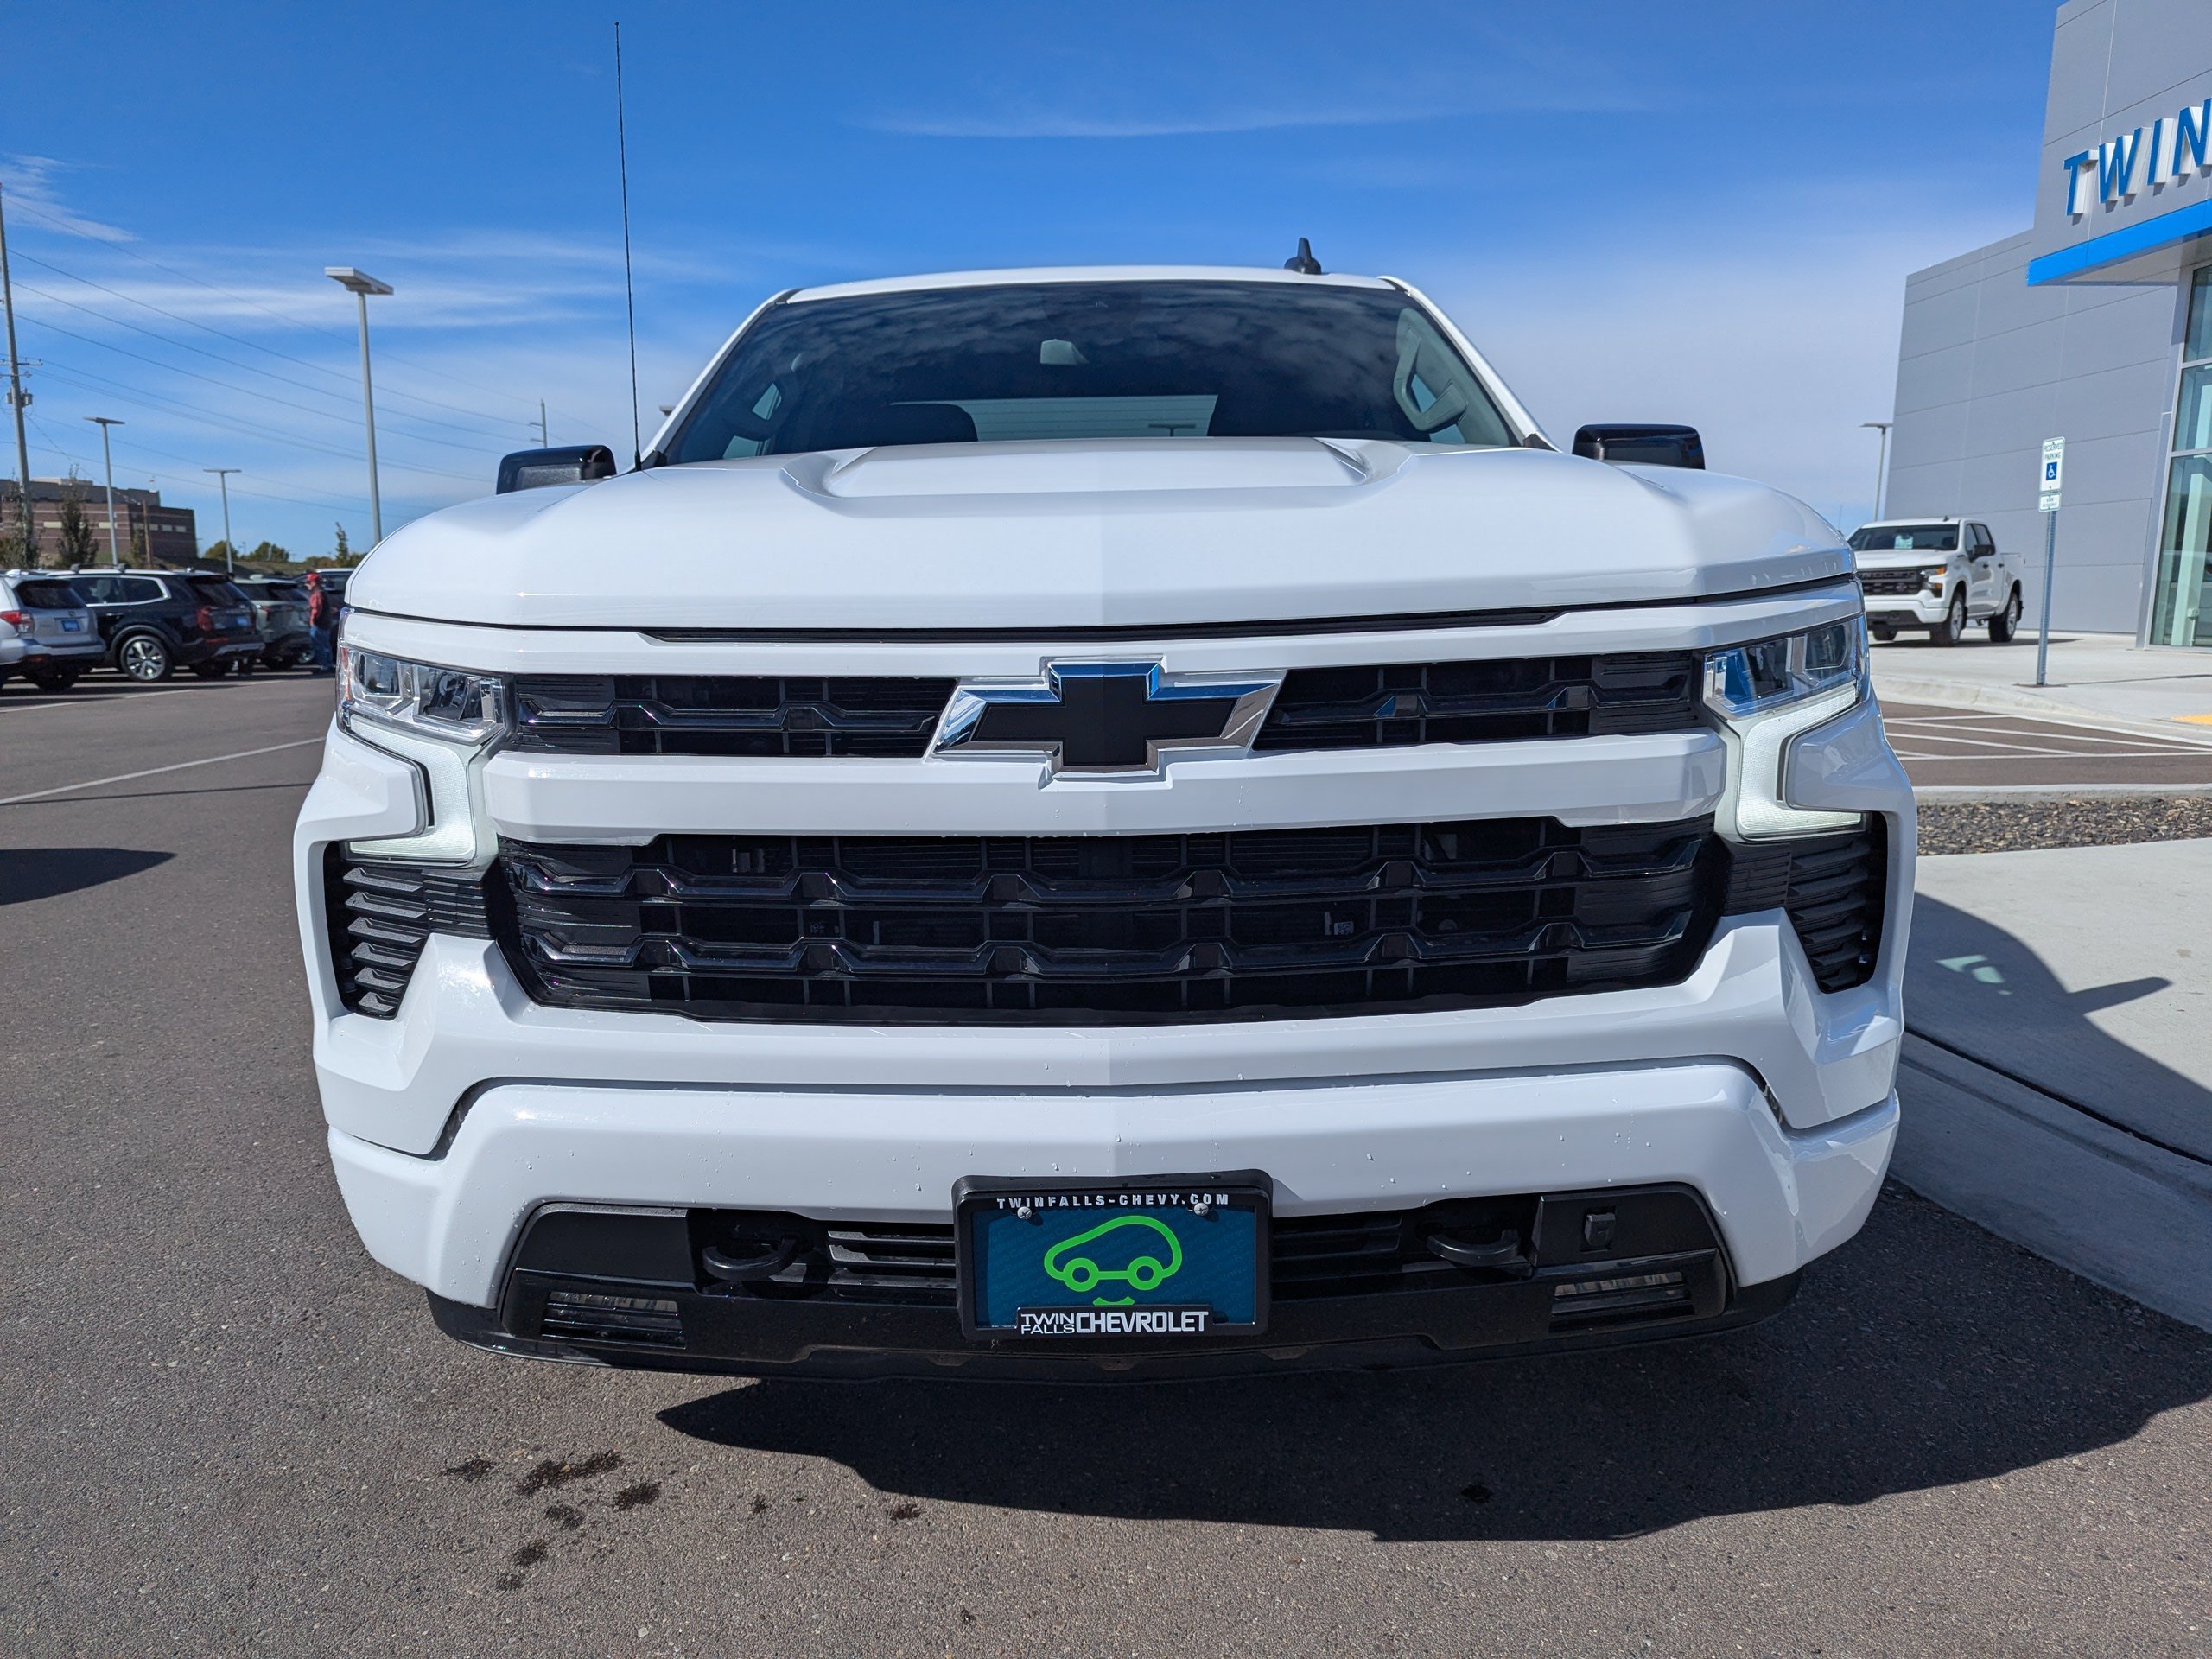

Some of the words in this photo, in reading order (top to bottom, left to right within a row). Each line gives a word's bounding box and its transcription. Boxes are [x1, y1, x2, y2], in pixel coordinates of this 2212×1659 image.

[2063, 98, 2212, 216] TWIN
[997, 1194, 1229, 1208] TWINFALLS-CHEVY.COM
[1021, 1313, 1075, 1324] TWIN
[1077, 1312, 1209, 1332] CHEVROLET
[1021, 1325, 1075, 1334] FALLS
